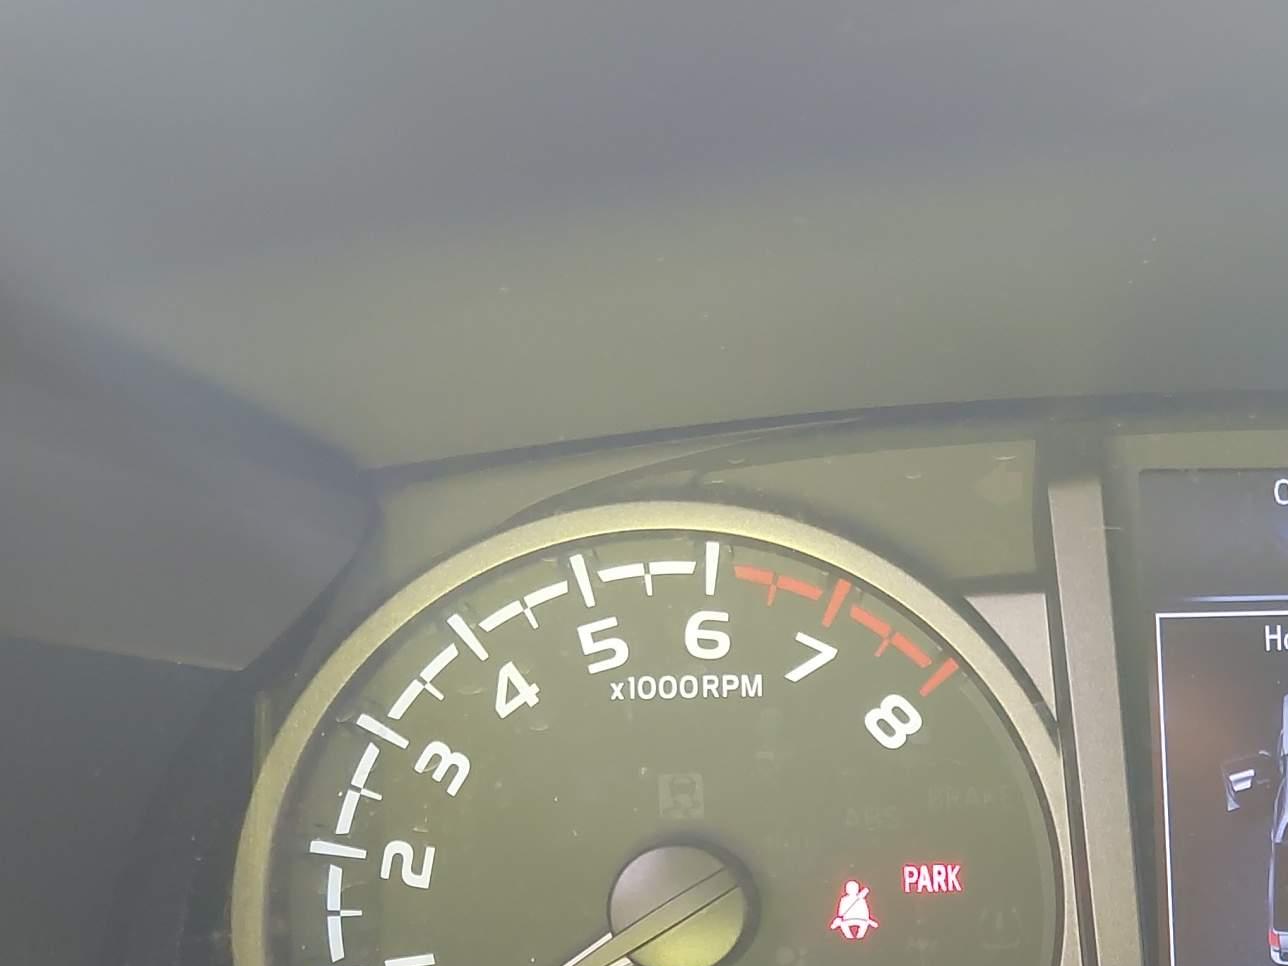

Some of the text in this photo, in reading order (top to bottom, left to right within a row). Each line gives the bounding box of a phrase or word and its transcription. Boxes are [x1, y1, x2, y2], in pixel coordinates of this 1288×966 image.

[576, 616, 629, 674] 5
[684, 610, 731, 660] 6
[784, 631, 838, 682] 7
[494, 661, 540, 719] 4
[864, 694, 923, 749] 8
[414, 740, 471, 797] 3
[380, 840, 436, 889] 2
[903, 863, 963, 894] PARK
